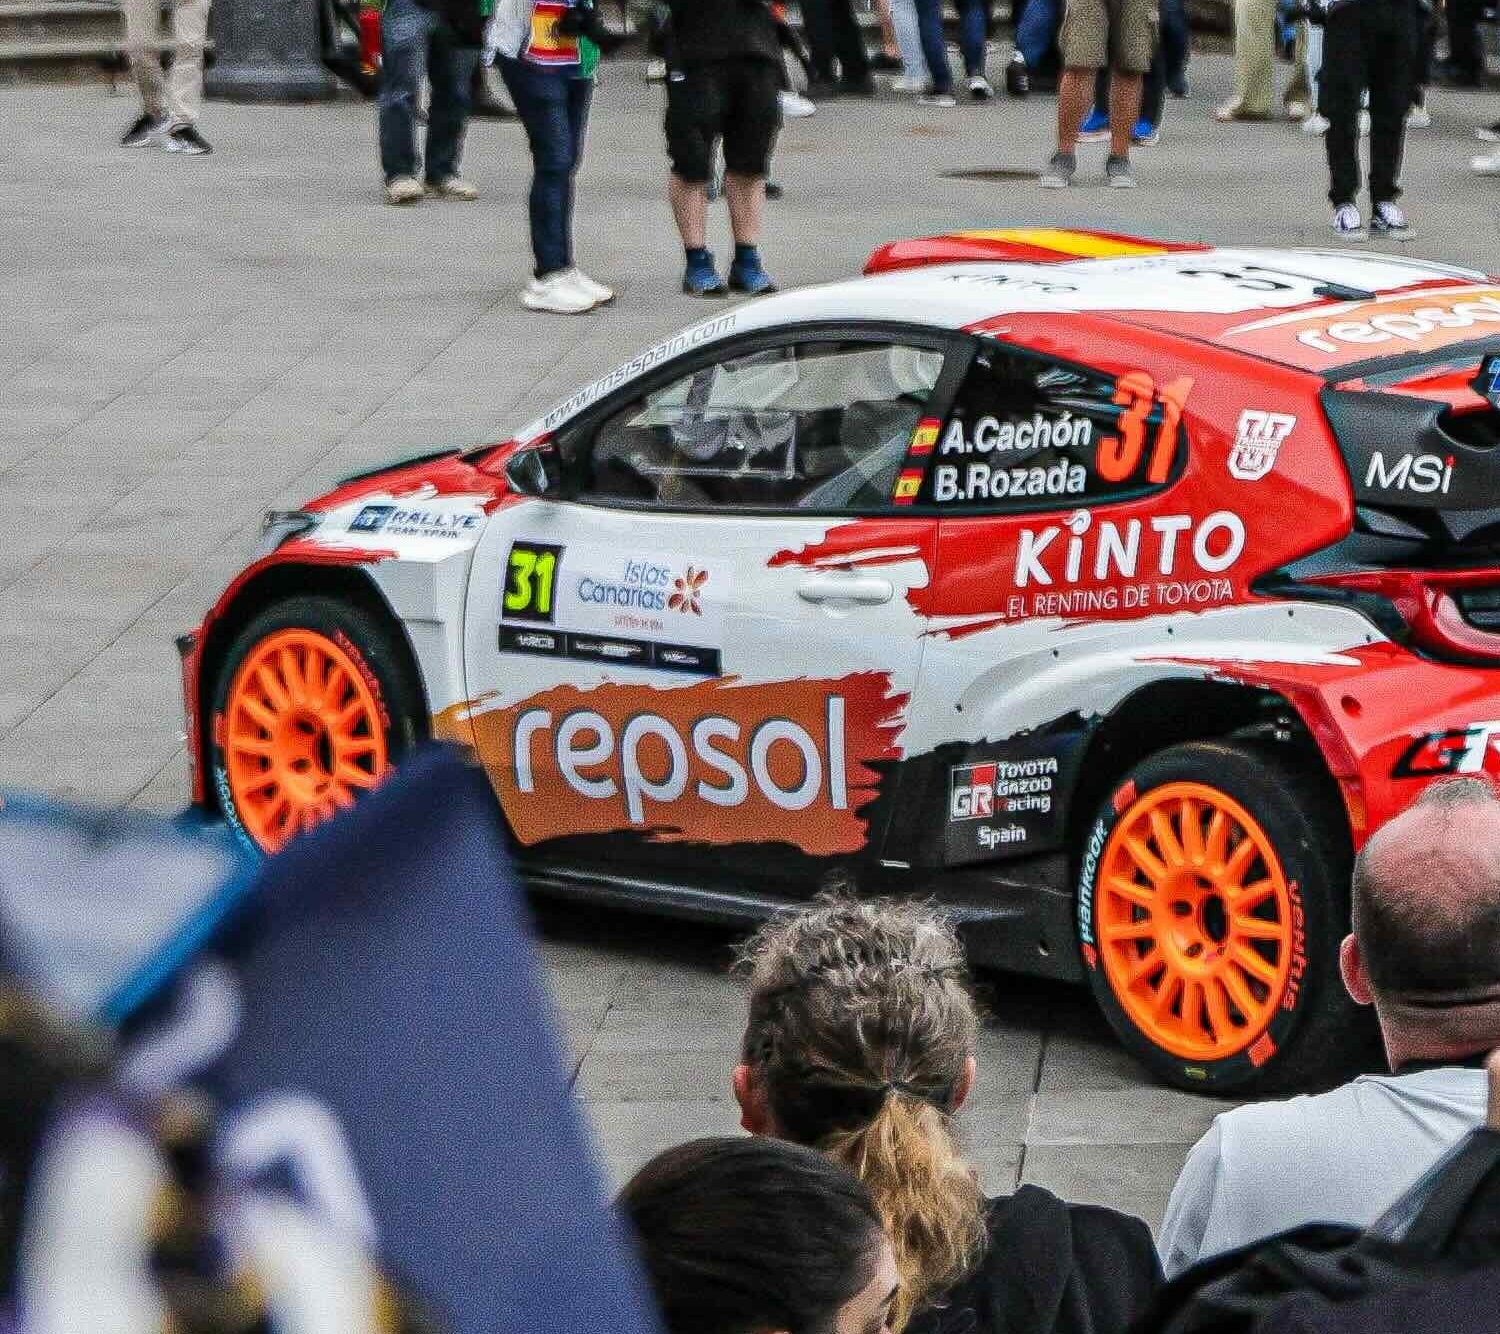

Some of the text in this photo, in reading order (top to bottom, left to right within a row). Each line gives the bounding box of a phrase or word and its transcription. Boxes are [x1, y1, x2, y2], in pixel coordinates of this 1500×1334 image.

[1096, 370, 1194, 484] 31
[933, 458, 1088, 503] B.Rozada
[390, 510, 481, 530] RALLYE
[502, 547, 557, 614] 31
[623, 558, 671, 586] Islas
[576, 578, 667, 611] Canarias
[1007, 579, 1234, 619] EL RENTING DE TOYOTA
[514, 693, 848, 824] repsol
[998, 758, 1058, 779] TOYOTA
[952, 785, 993, 818] GR
[997, 776, 1052, 794] GAZOO
[991, 797, 1051, 815] Racing
[976, 825, 1027, 850] Spain
